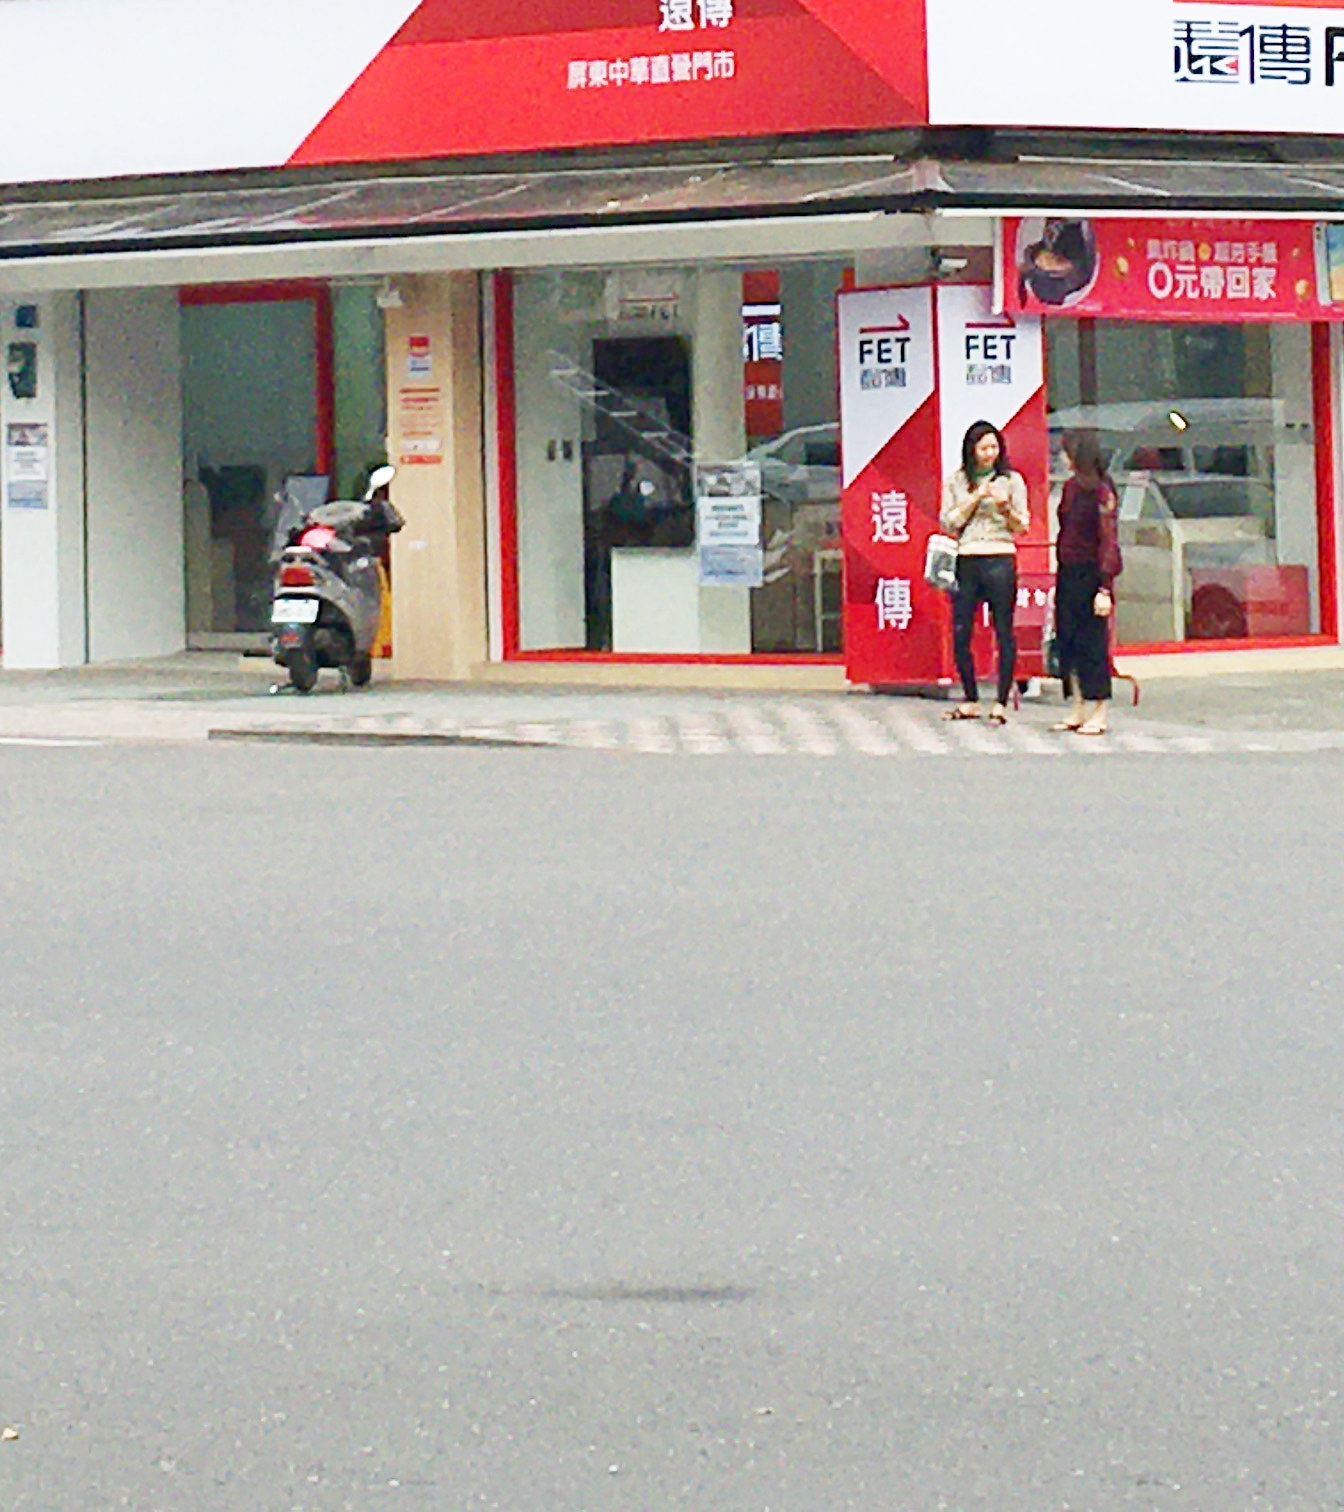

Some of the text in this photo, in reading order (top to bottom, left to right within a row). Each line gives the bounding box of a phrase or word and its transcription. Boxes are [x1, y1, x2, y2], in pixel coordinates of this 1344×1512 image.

[566, 49, 736, 90] 屏東中華直營門市
[1172, 18, 1312, 86] 遠傳
[859, 337, 911, 365] FET
[965, 334, 1016, 360] FET
[871, 489, 913, 631] 遠傳
